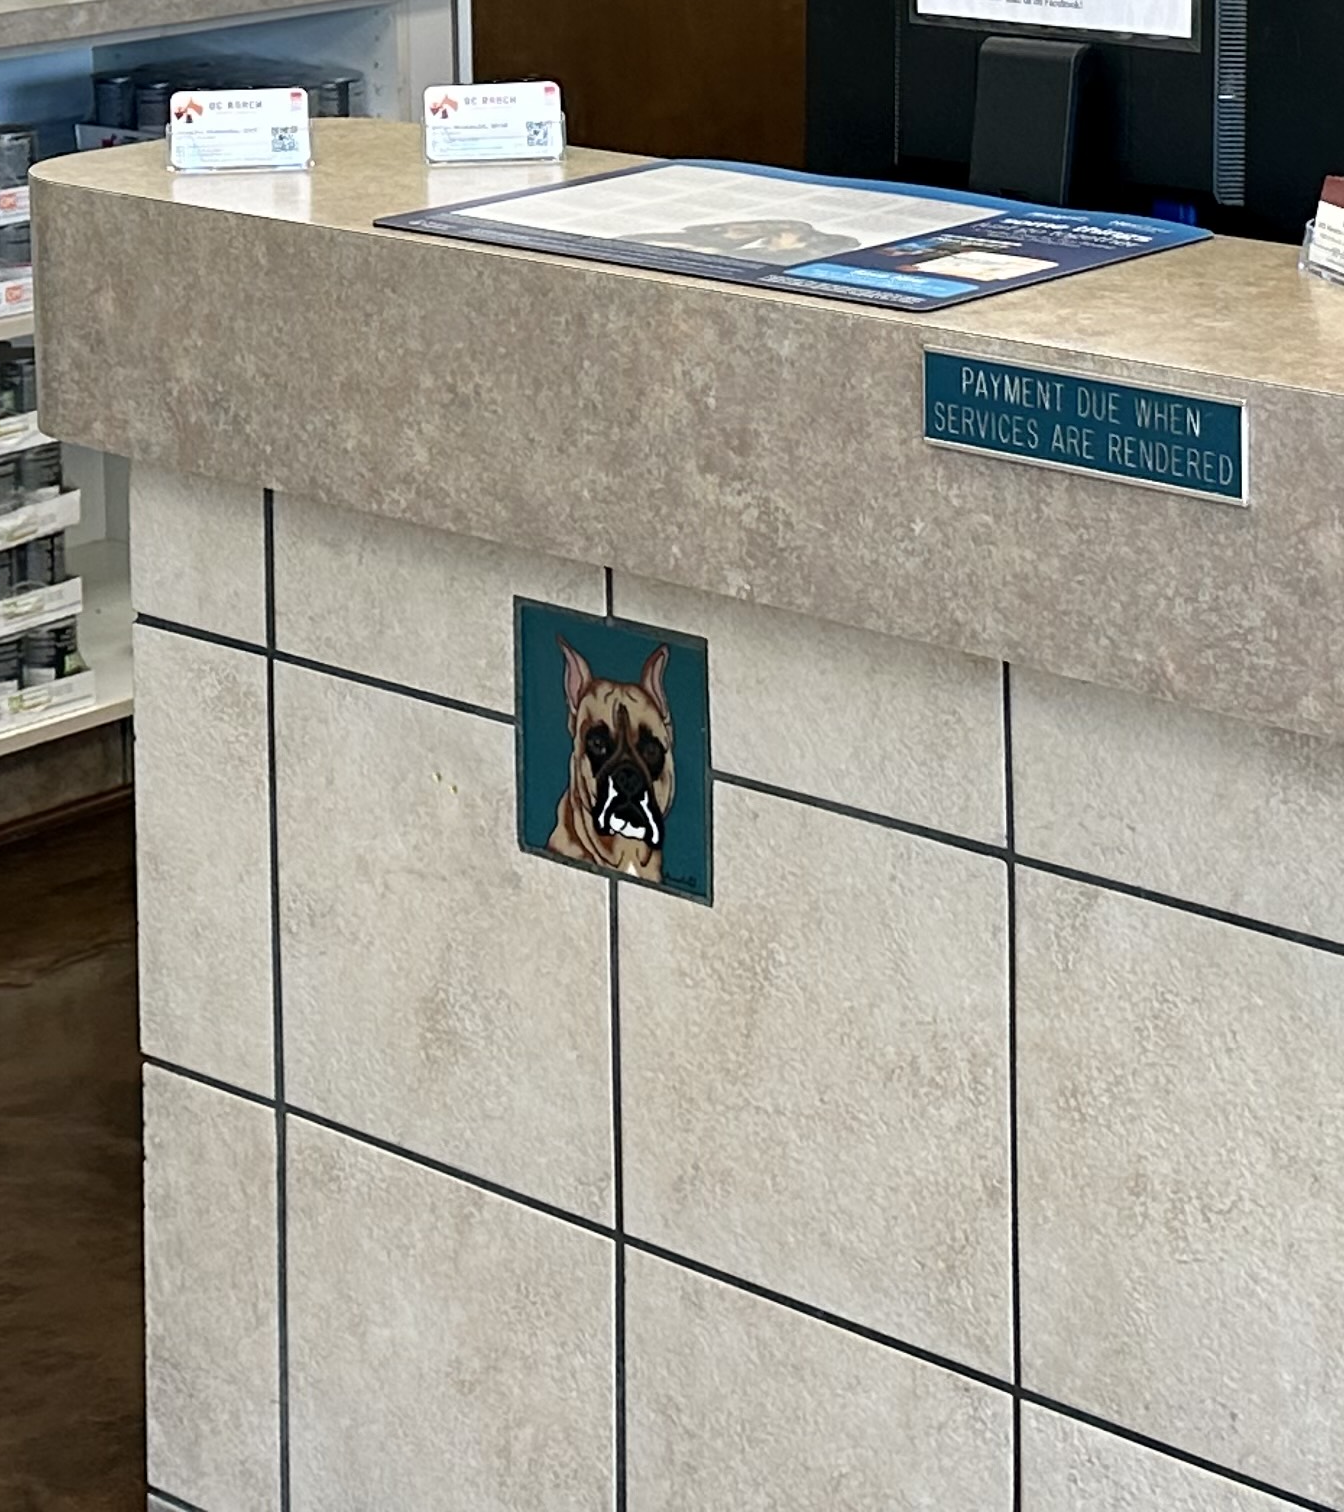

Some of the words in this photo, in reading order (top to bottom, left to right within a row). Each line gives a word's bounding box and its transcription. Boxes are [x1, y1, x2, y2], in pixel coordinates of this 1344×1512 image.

[961, 366, 1064, 413] PAYMENT
[1076, 385, 1122, 425] DUE
[1134, 397, 1202, 438] WHEN
[933, 401, 1039, 450] SERVICES
[1051, 423, 1096, 460] ARE
[1107, 433, 1235, 487] RENDERED
